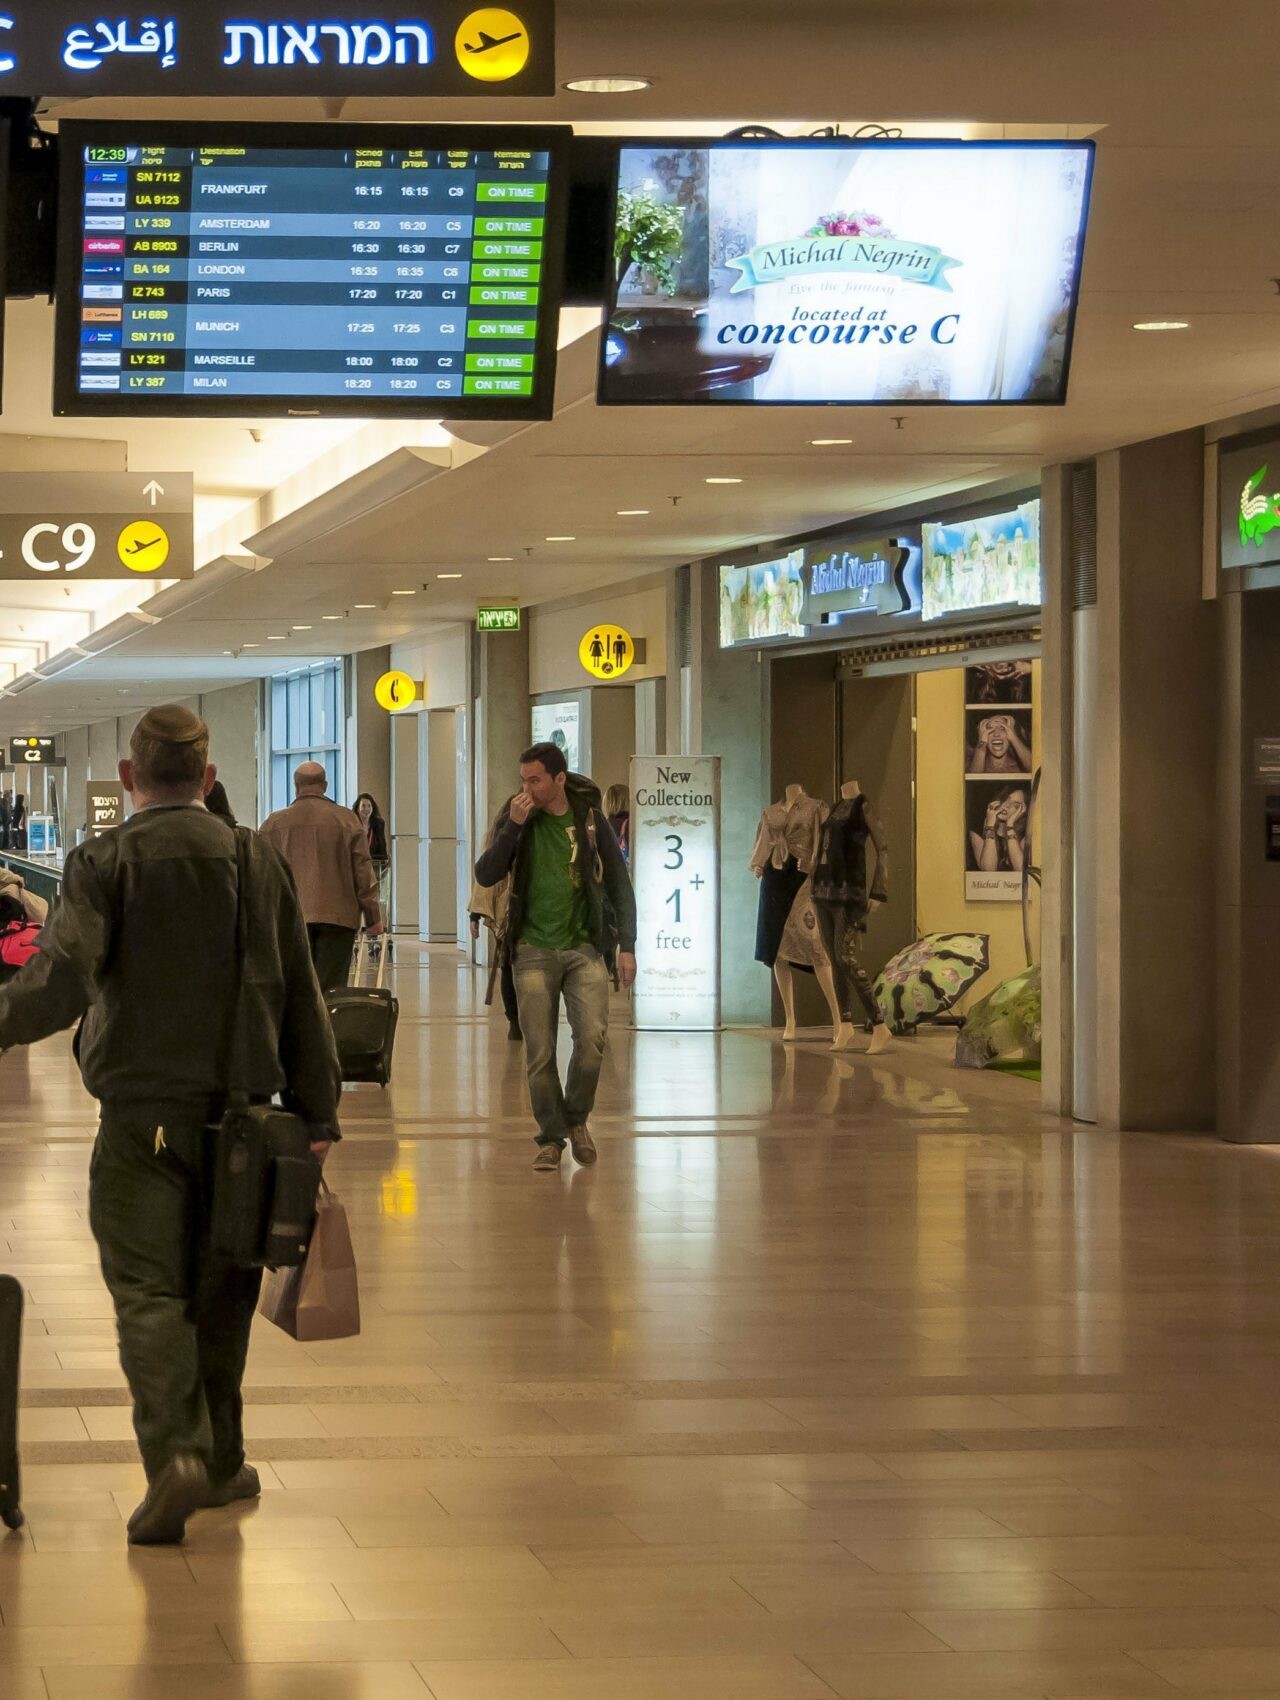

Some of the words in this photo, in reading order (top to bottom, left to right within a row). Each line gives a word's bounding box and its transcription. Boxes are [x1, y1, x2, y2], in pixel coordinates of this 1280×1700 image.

[64, 20, 176, 70] إقلاع
[223, 23, 429, 65] המראות
[90, 149, 126, 161] 12:39
[135, 218, 149, 228] LY
[151, 218, 171, 228] 339
[199, 219, 270, 229] AMSTERDAM
[352, 221, 380, 230] 16:20
[399, 221, 427, 230] 16:20
[446, 222, 461, 231] C5
[486, 222, 504, 231] ON
[506, 222, 532, 231] TIME
[134, 242, 150, 251] AB
[199, 242, 239, 251] BERLIN
[351, 244, 379, 253] 16:30
[398, 244, 425, 253] 16:30
[445, 245, 460, 253] C7
[485, 246, 502, 254] ON
[505, 246, 530, 255] TIME
[762, 240, 850, 270] Michal
[852, 243, 932, 273] Negrin
[791, 306, 864, 322] located
[867, 308, 888, 321] at
[717, 323, 918, 345] concourse
[930, 314, 960, 345] C
[130, 355, 145, 364] LY
[147, 355, 165, 364] 321
[194, 356, 255, 365] MARSEILLE
[345, 357, 373, 366] 18:00
[391, 357, 418, 366] 18:00
[438, 357, 453, 367] C2
[477, 358, 494, 367] ON
[497, 358, 522, 367] TIME
[21, 522, 96, 572] C9
[24, 750, 41, 762] C2
[656, 766, 692, 784] New
[636, 788, 713, 807] Collection
[664, 834, 684, 870] 3
[665, 888, 681, 923] 1
[656, 929, 692, 950] free
